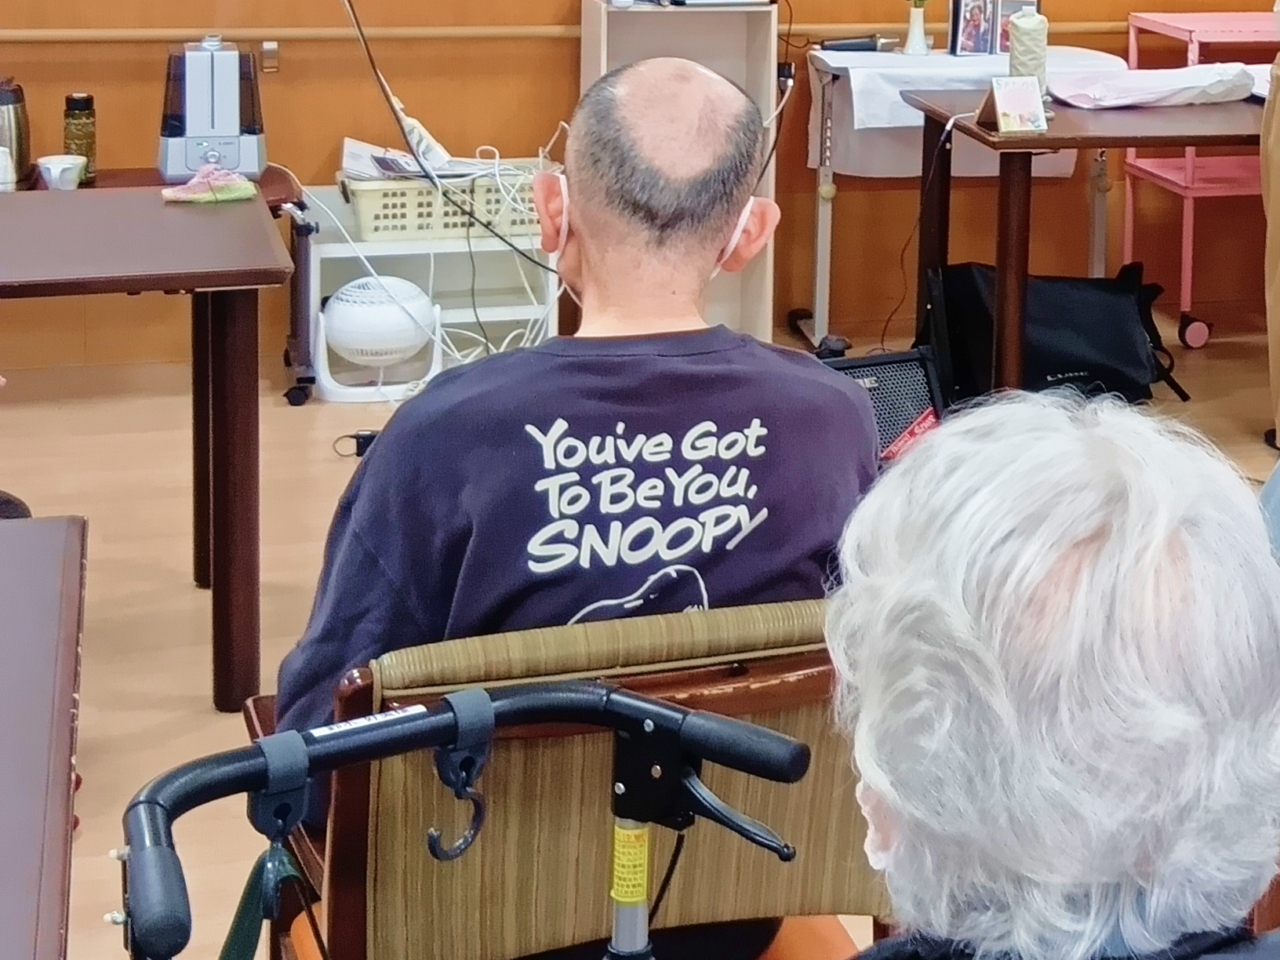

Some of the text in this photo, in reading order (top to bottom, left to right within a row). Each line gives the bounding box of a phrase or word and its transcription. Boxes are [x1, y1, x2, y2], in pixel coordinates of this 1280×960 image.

[525, 418, 768, 469] You've Got
[534, 472, 591, 519] To
[591, 468, 665, 514] Be
[527, 505, 768, 573] SNOOPY
